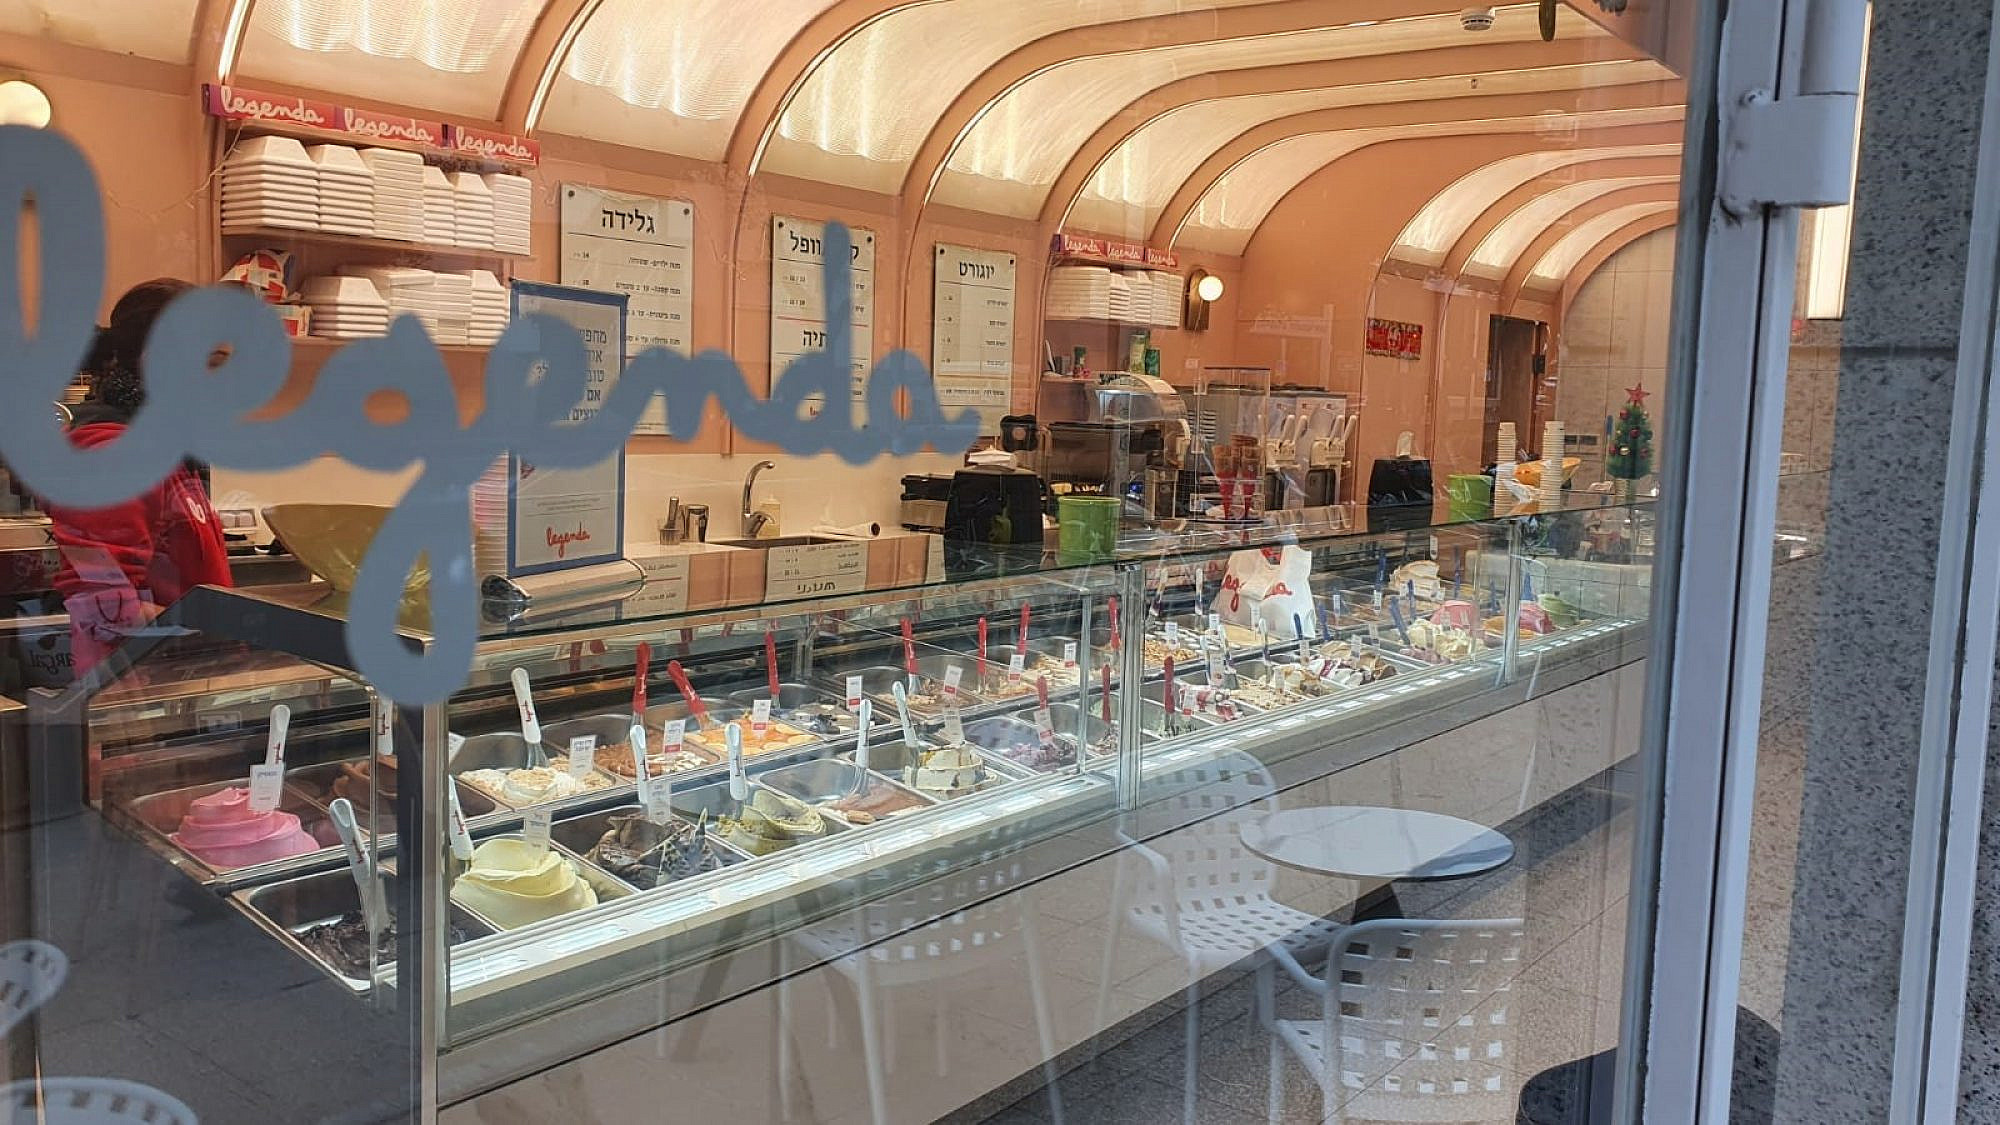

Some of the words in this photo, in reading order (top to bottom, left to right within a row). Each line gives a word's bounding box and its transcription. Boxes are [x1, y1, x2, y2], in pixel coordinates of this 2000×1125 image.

[220, 86, 325, 124] legenda
[345, 109, 434, 143] legenda
[455, 126, 532, 159] legenda
[602, 208, 655, 234] גלידה
[959, 261, 995, 280] יוגורט
[0, 124, 980, 706] legenda
[545, 520, 591, 558] legenda
